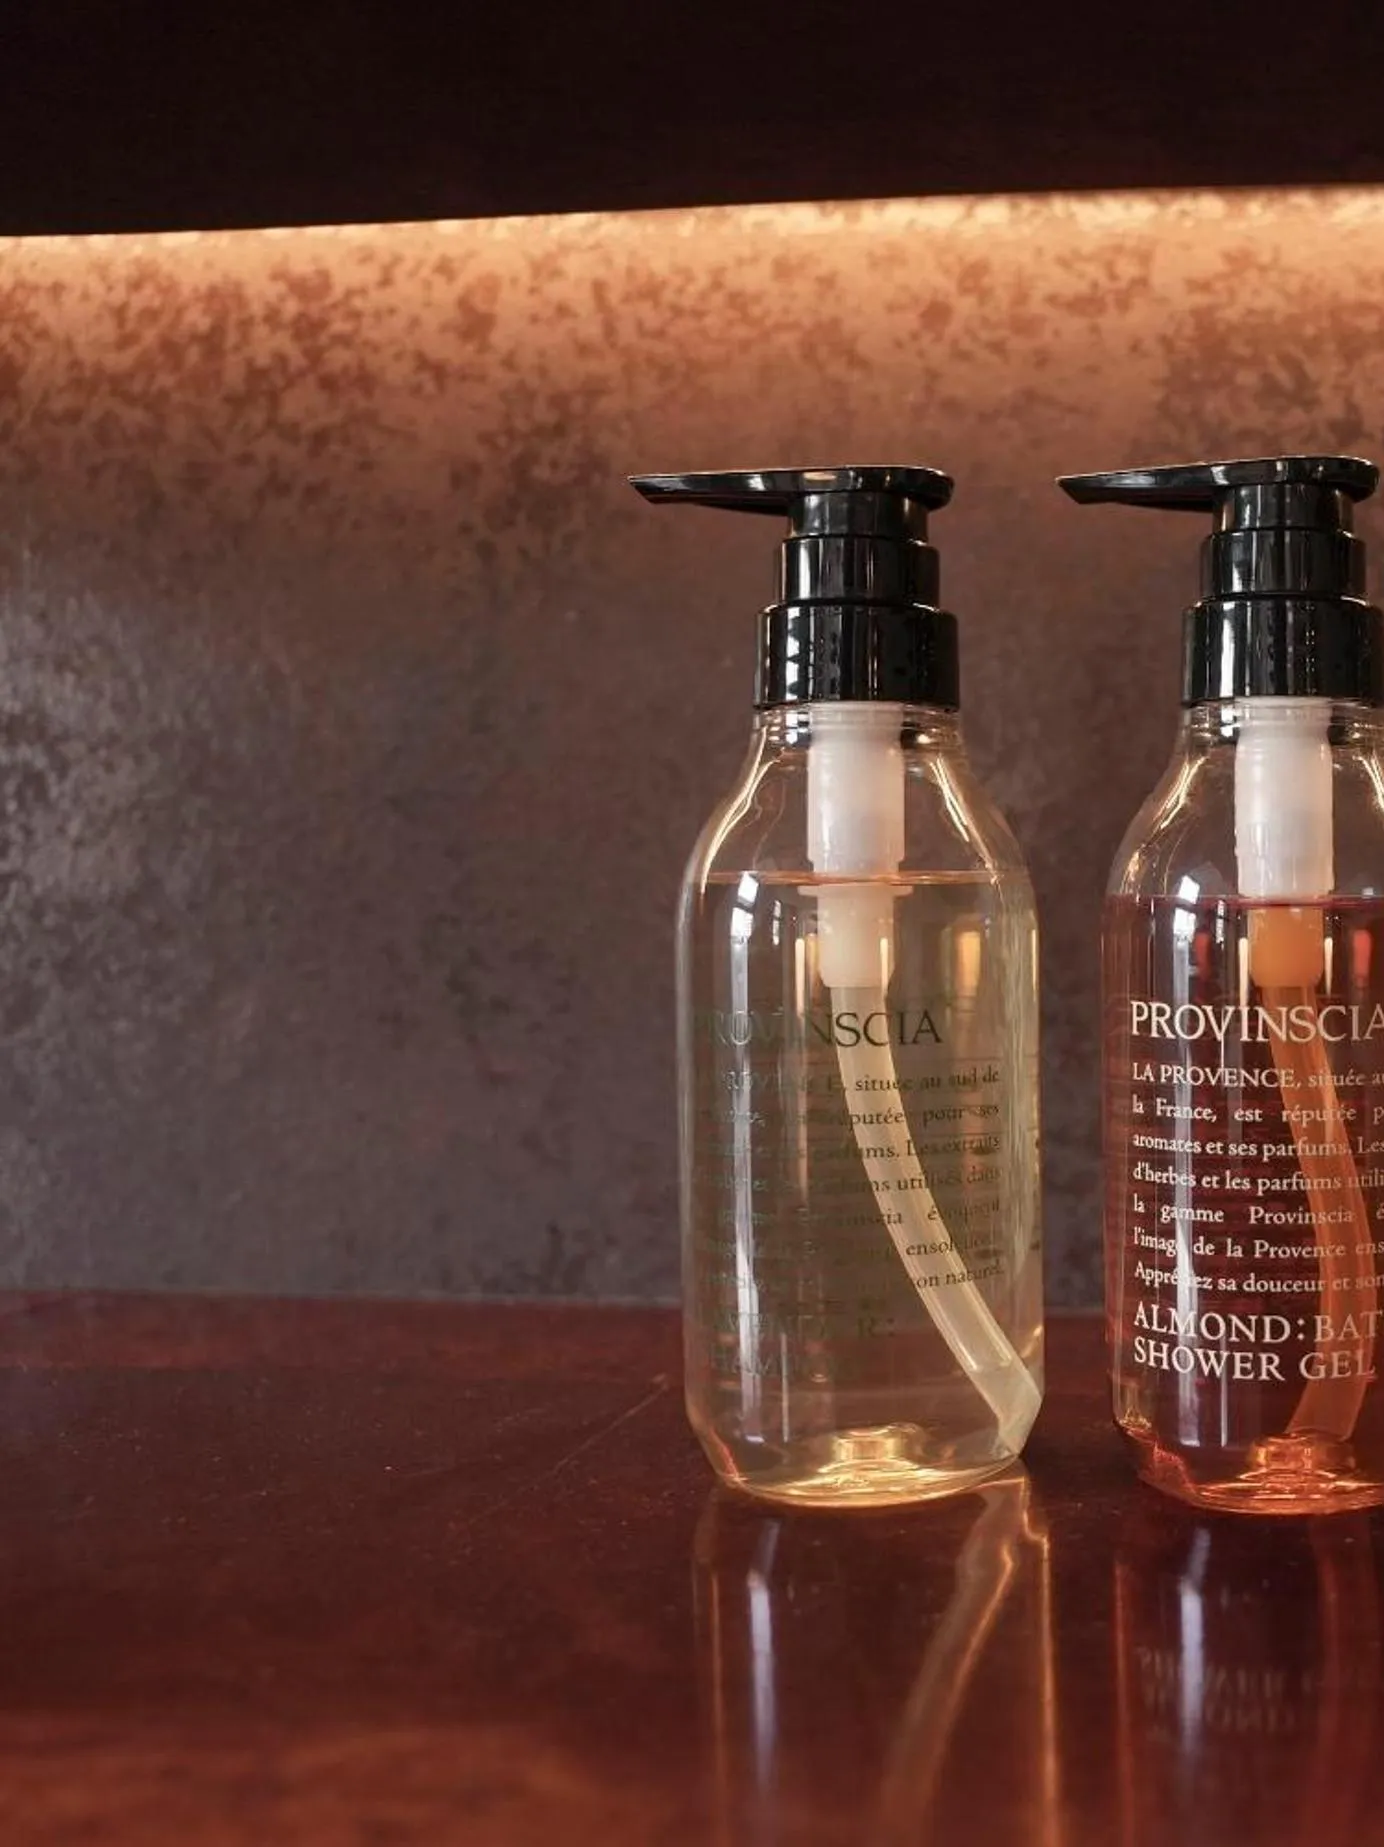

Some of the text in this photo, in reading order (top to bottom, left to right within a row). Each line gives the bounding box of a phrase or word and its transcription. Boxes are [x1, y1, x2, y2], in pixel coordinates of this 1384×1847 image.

[1133, 1063, 1154, 1083] LA
[1160, 1065, 1301, 1088] PROVENCE,
[1308, 1070, 1364, 1086] située
[1133, 1095, 1144, 1113] la
[1156, 1098, 1217, 1123] France,
[1234, 1106, 1262, 1121] est
[1281, 1102, 1357, 1128] réputée
[1133, 1133, 1201, 1153] aromates
[1206, 1140, 1224, 1154] et
[1229, 1142, 1257, 1155] ses
[1263, 1137, 1351, 1161] parfums.
[1133, 1165, 1196, 1186] d'herbes
[1202, 1173, 1219, 1187] et
[1225, 1171, 1250, 1189] les
[1258, 1171, 1341, 1195] parfums
[1134, 1196, 1144, 1212] la
[1160, 1204, 1224, 1223] gamme
[1249, 1206, 1353, 1225] Provinscia
[1193, 1237, 1215, 1255] de
[1226, 1238, 1243, 1257] la
[1254, 1240, 1346, 1259] Provence
[1218, 1276, 1236, 1291] sa
[1243, 1272, 1324, 1292] douceur
[1332, 1276, 1349, 1289] et
[1134, 1338, 1376, 1381] SHOWER GEL
